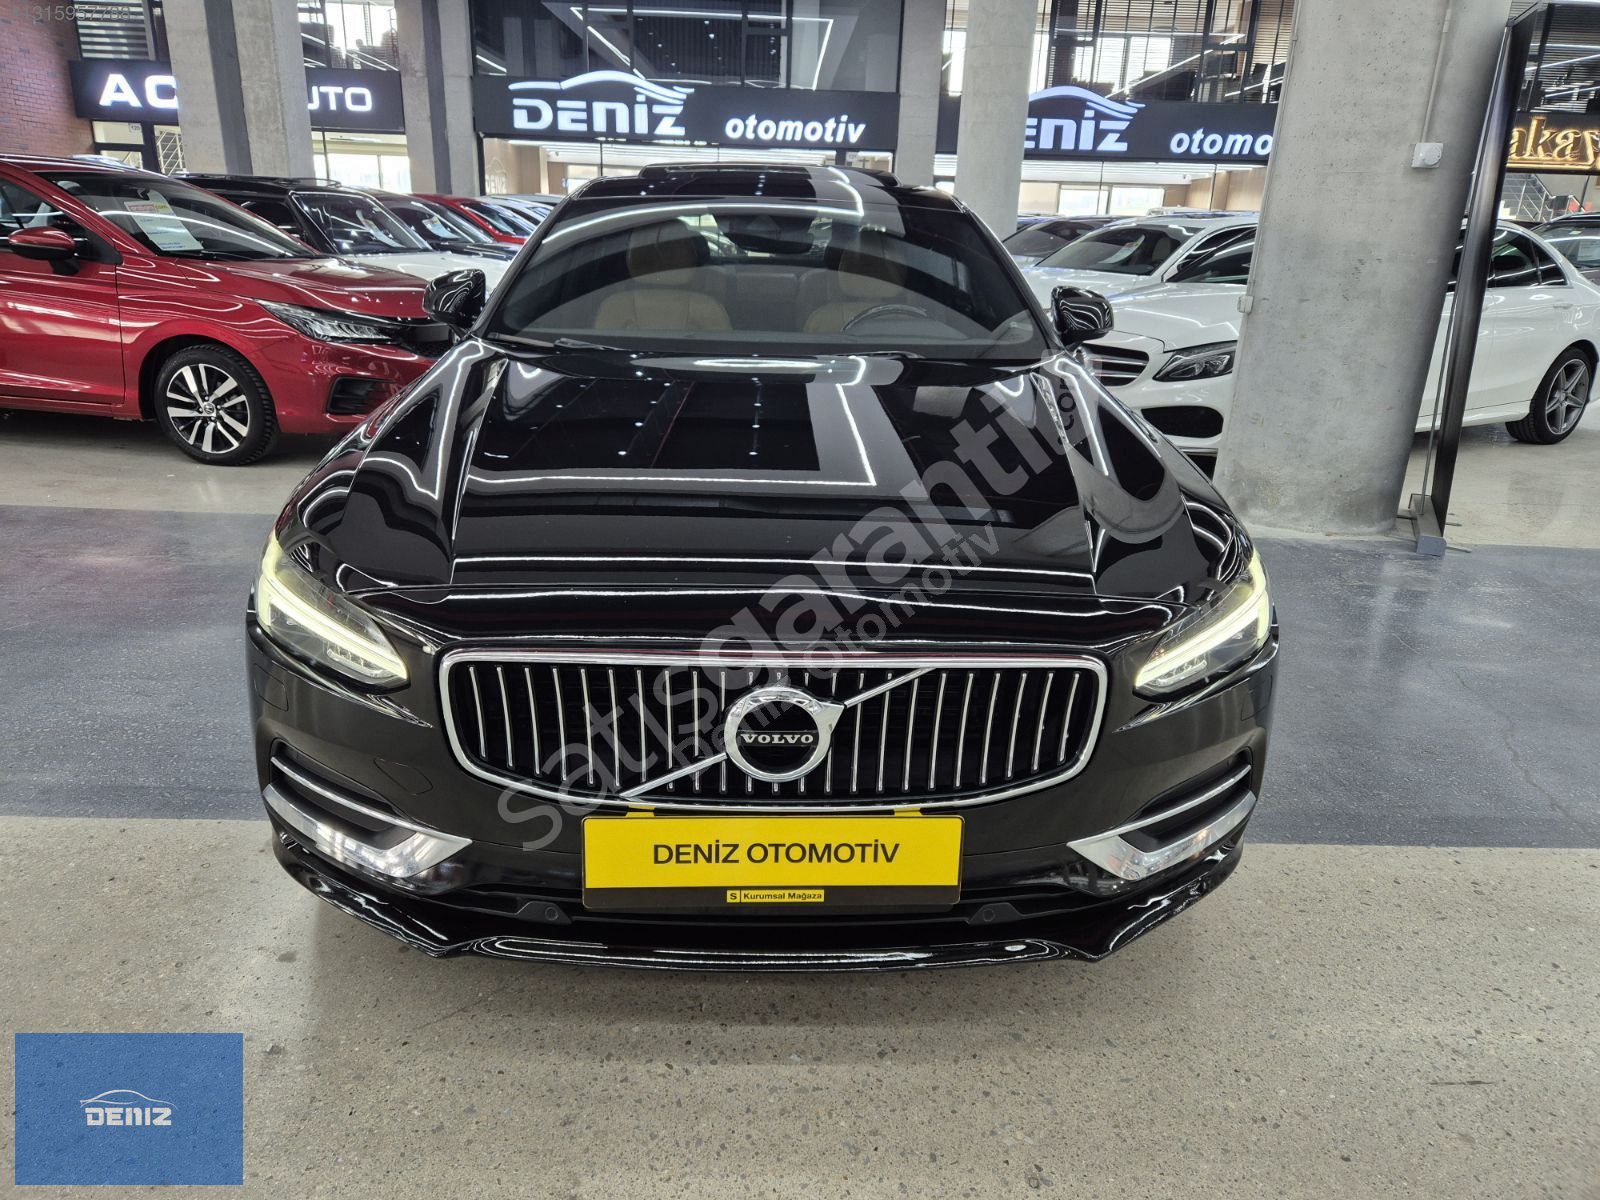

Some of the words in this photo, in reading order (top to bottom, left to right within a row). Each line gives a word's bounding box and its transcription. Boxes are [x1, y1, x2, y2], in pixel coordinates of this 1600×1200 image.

[724, 114, 867, 144] otomotiv
[740, 733, 814, 744] VOLVO
[653, 839, 740, 864] DENİZ
[746, 838, 900, 864] OTOMOTİV
[743, 892, 786, 900] Kurumsal
[787, 892, 823, 901] Mağaza
